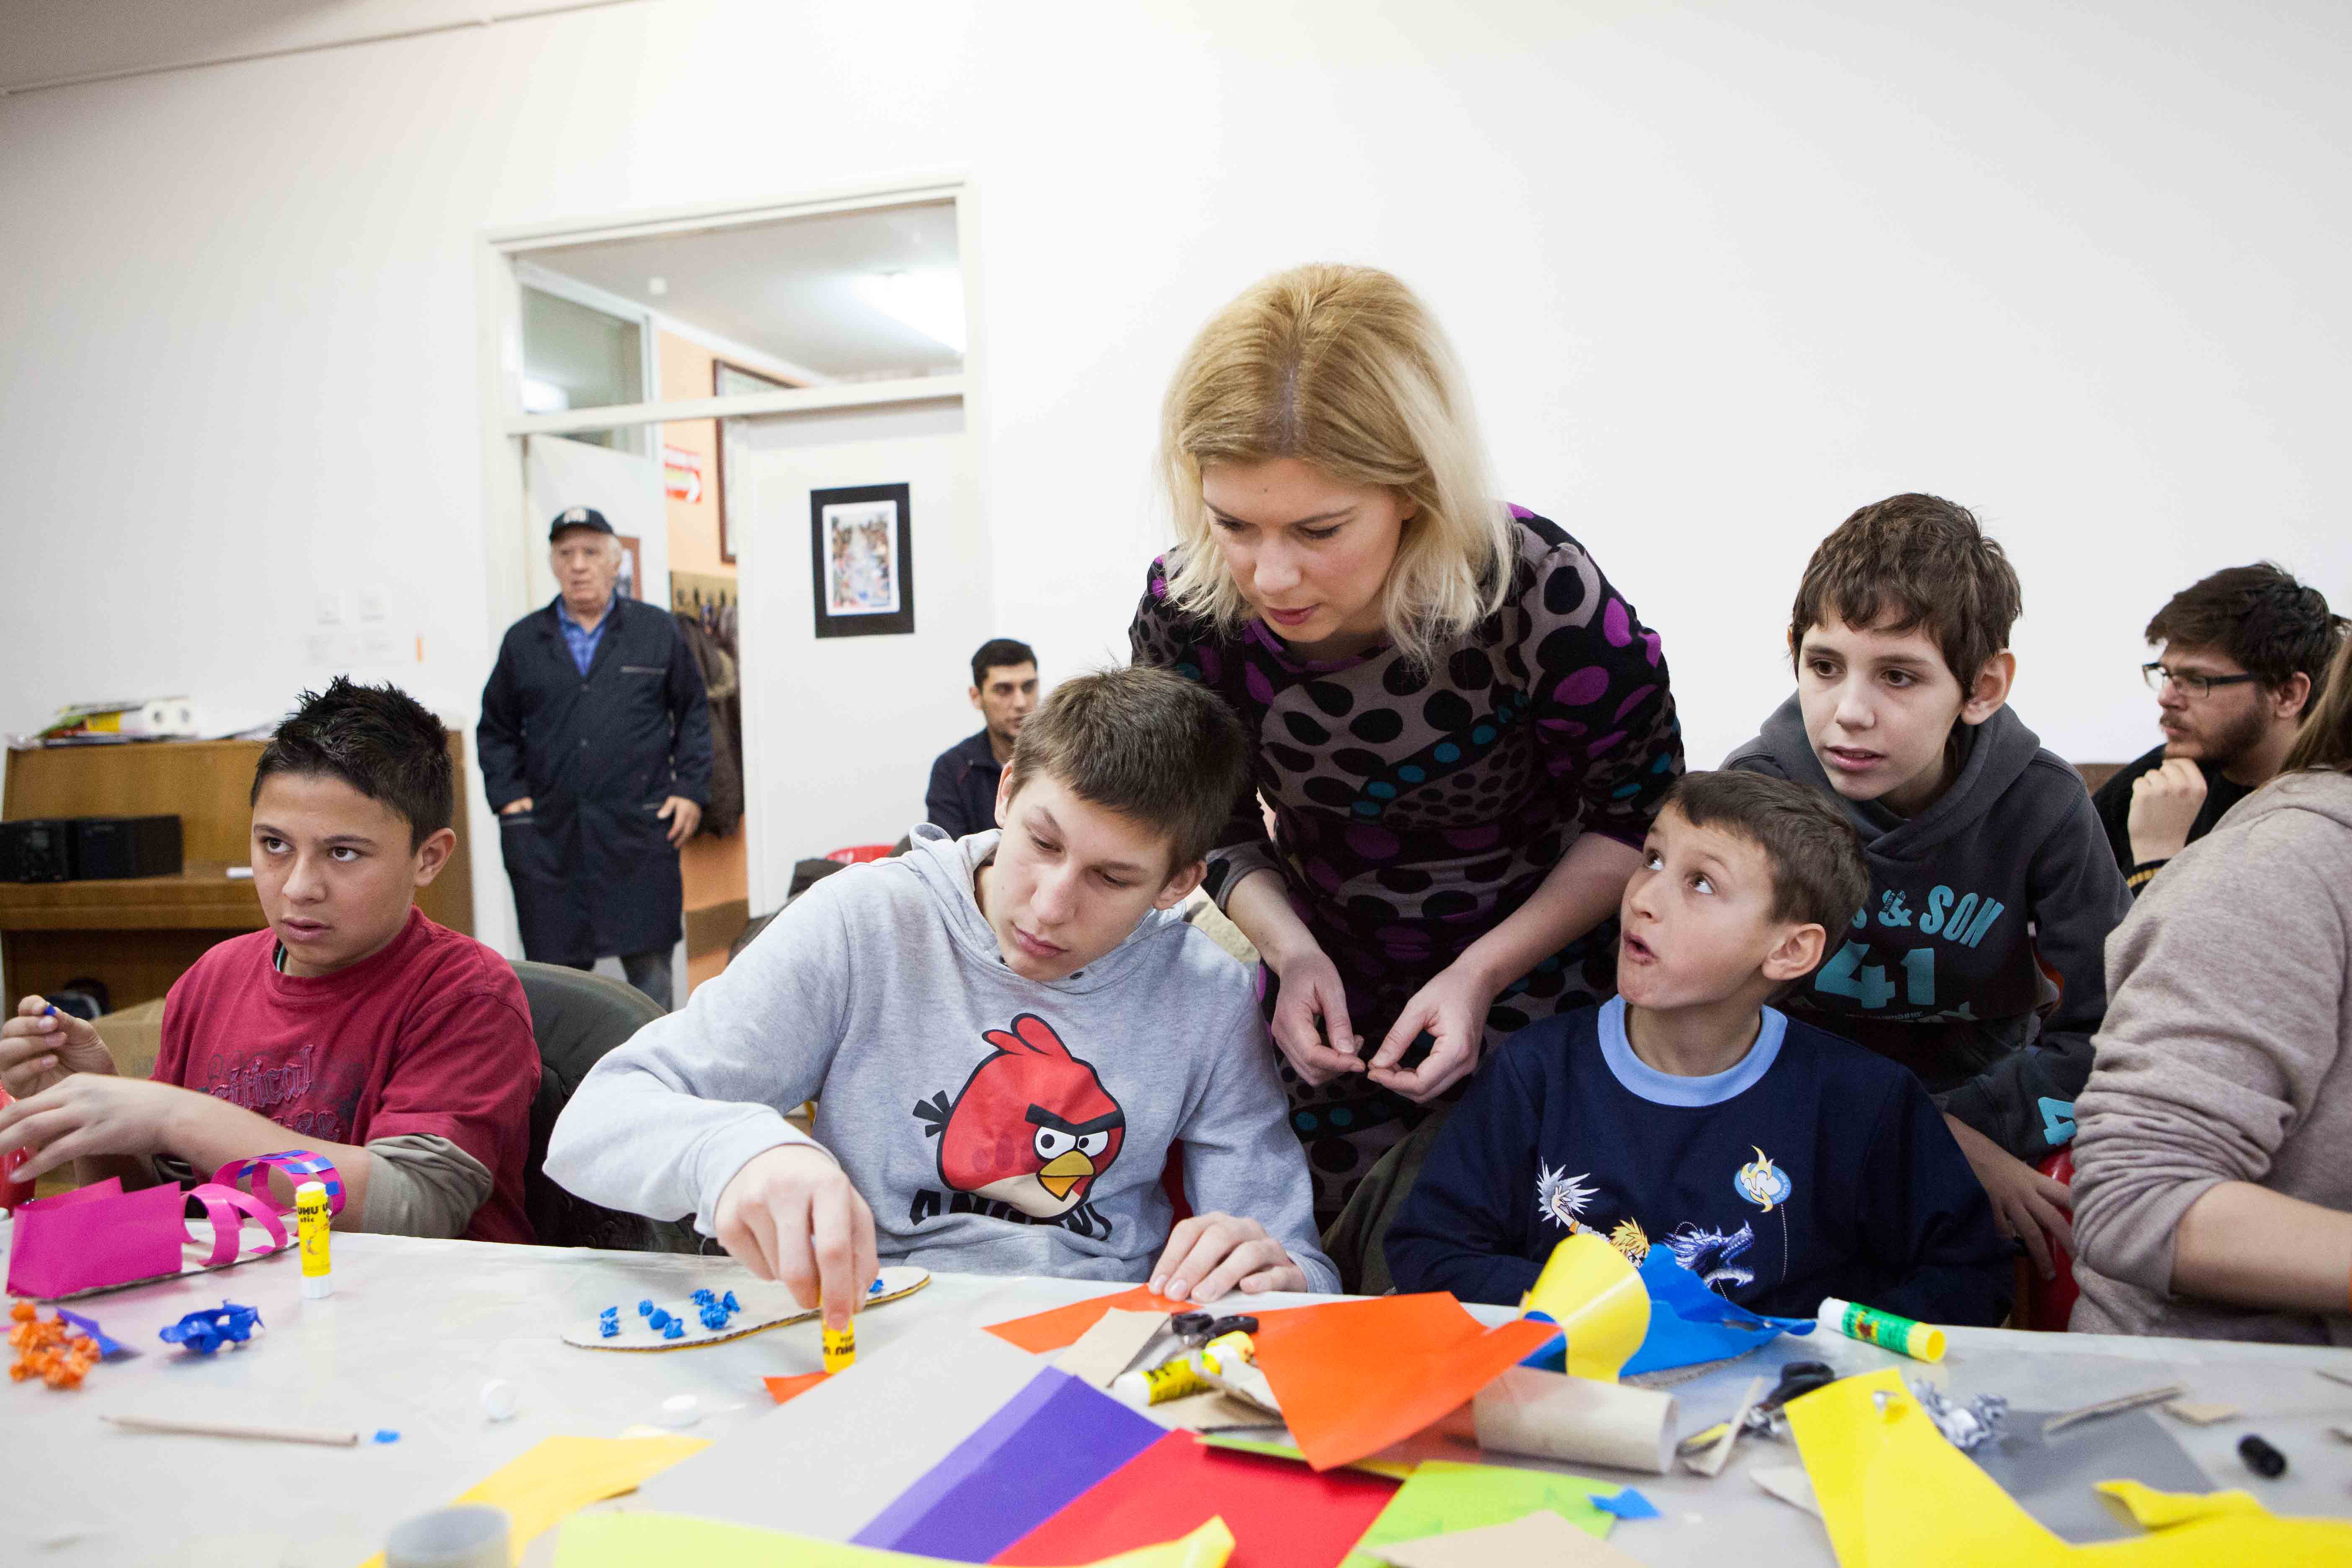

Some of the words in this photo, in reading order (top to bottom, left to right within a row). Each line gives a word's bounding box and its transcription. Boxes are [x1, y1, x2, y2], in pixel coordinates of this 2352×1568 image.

[1878, 889, 1913, 926] &
[1919, 885, 2005, 948] SON
[1815, 939, 1935, 1009] 41
[298, 1206, 319, 1215] UHU
